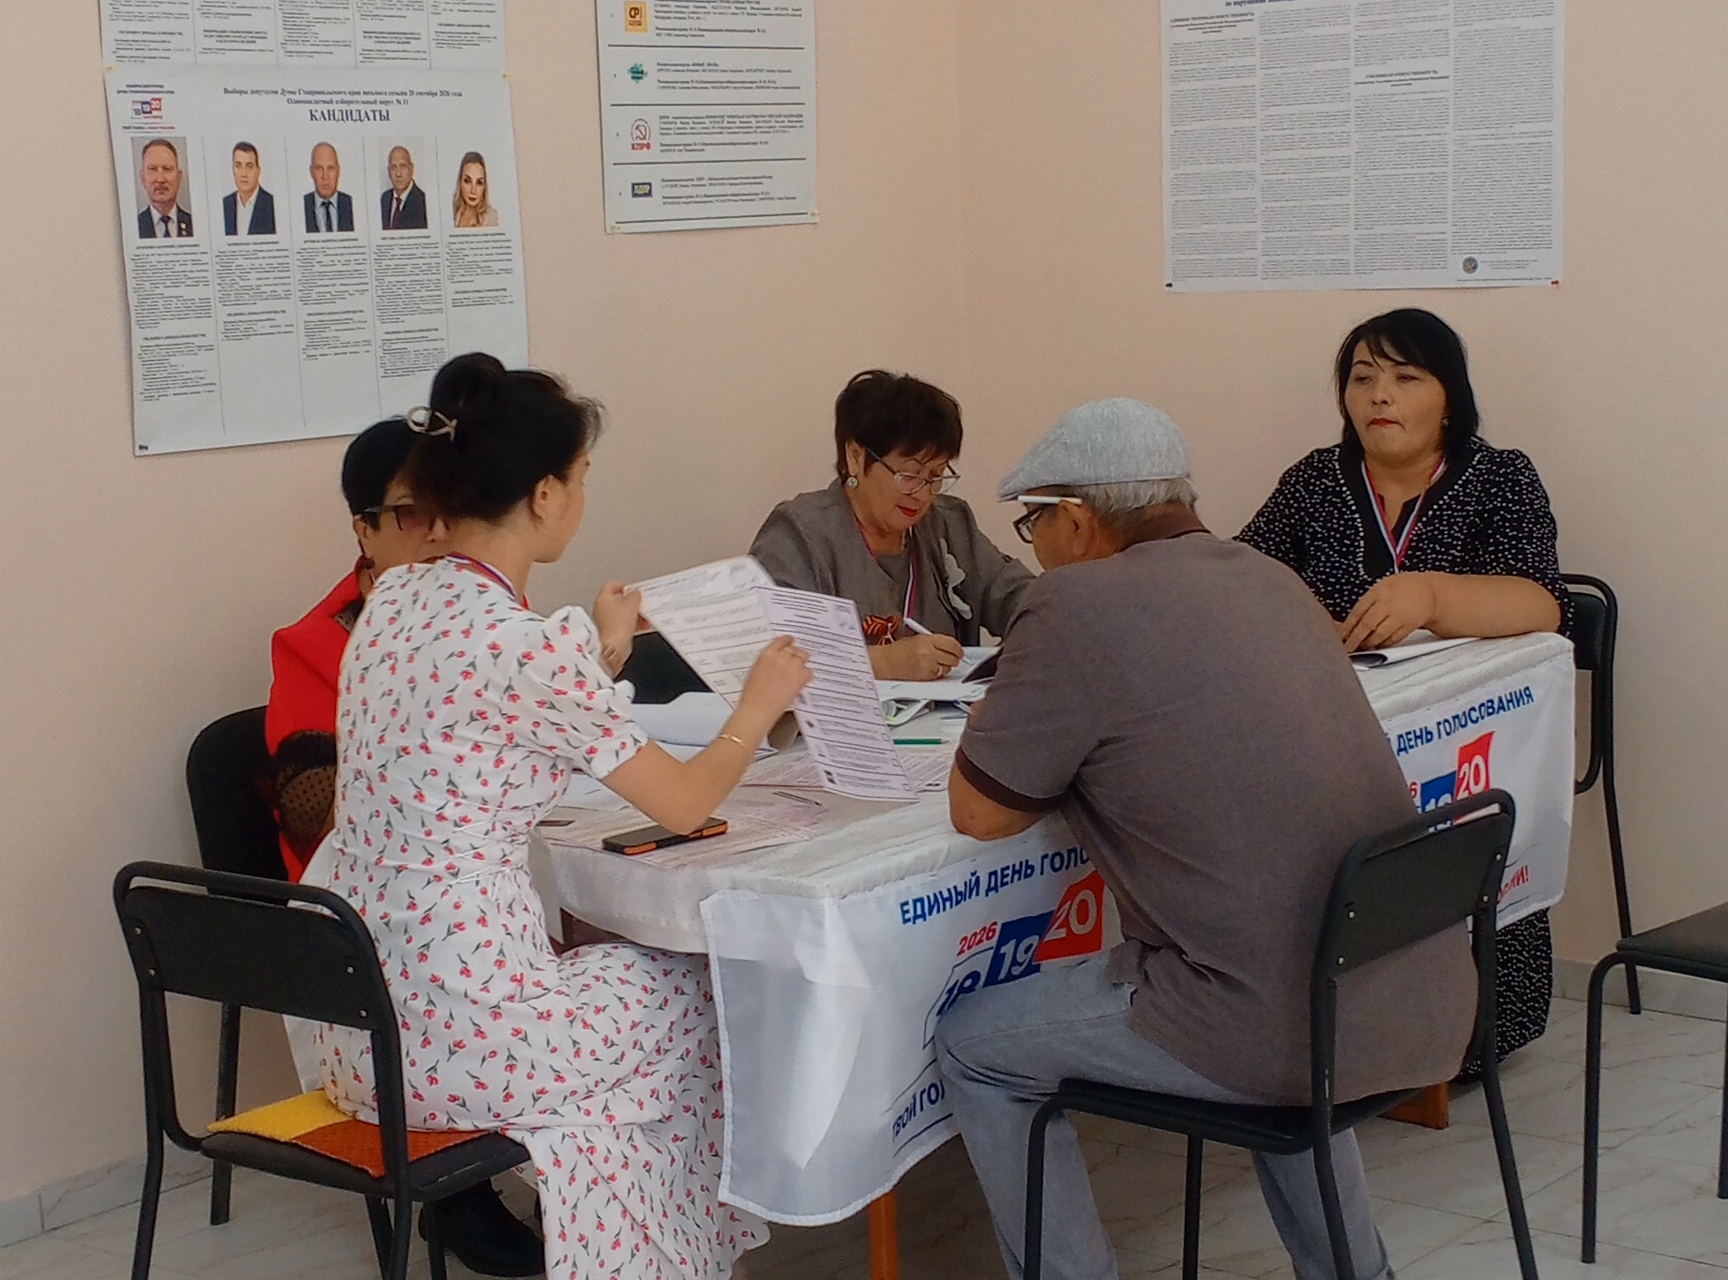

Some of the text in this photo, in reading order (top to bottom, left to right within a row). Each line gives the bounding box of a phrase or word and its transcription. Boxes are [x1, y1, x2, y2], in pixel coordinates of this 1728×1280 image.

[309, 109, 390, 122] КАНДИДАТЫ
[1396, 685, 1534, 756] ДЕНЬ ГОЛОСОВАНИЯ
[1456, 754, 1486, 800] 20
[900, 870, 981, 924] ЕДИНЫЙ
[985, 858, 1035, 897] ДЕНЬ
[957, 921, 997, 957] 2026
[996, 934, 1041, 981] 19
[1041, 889, 1097, 943] 20
